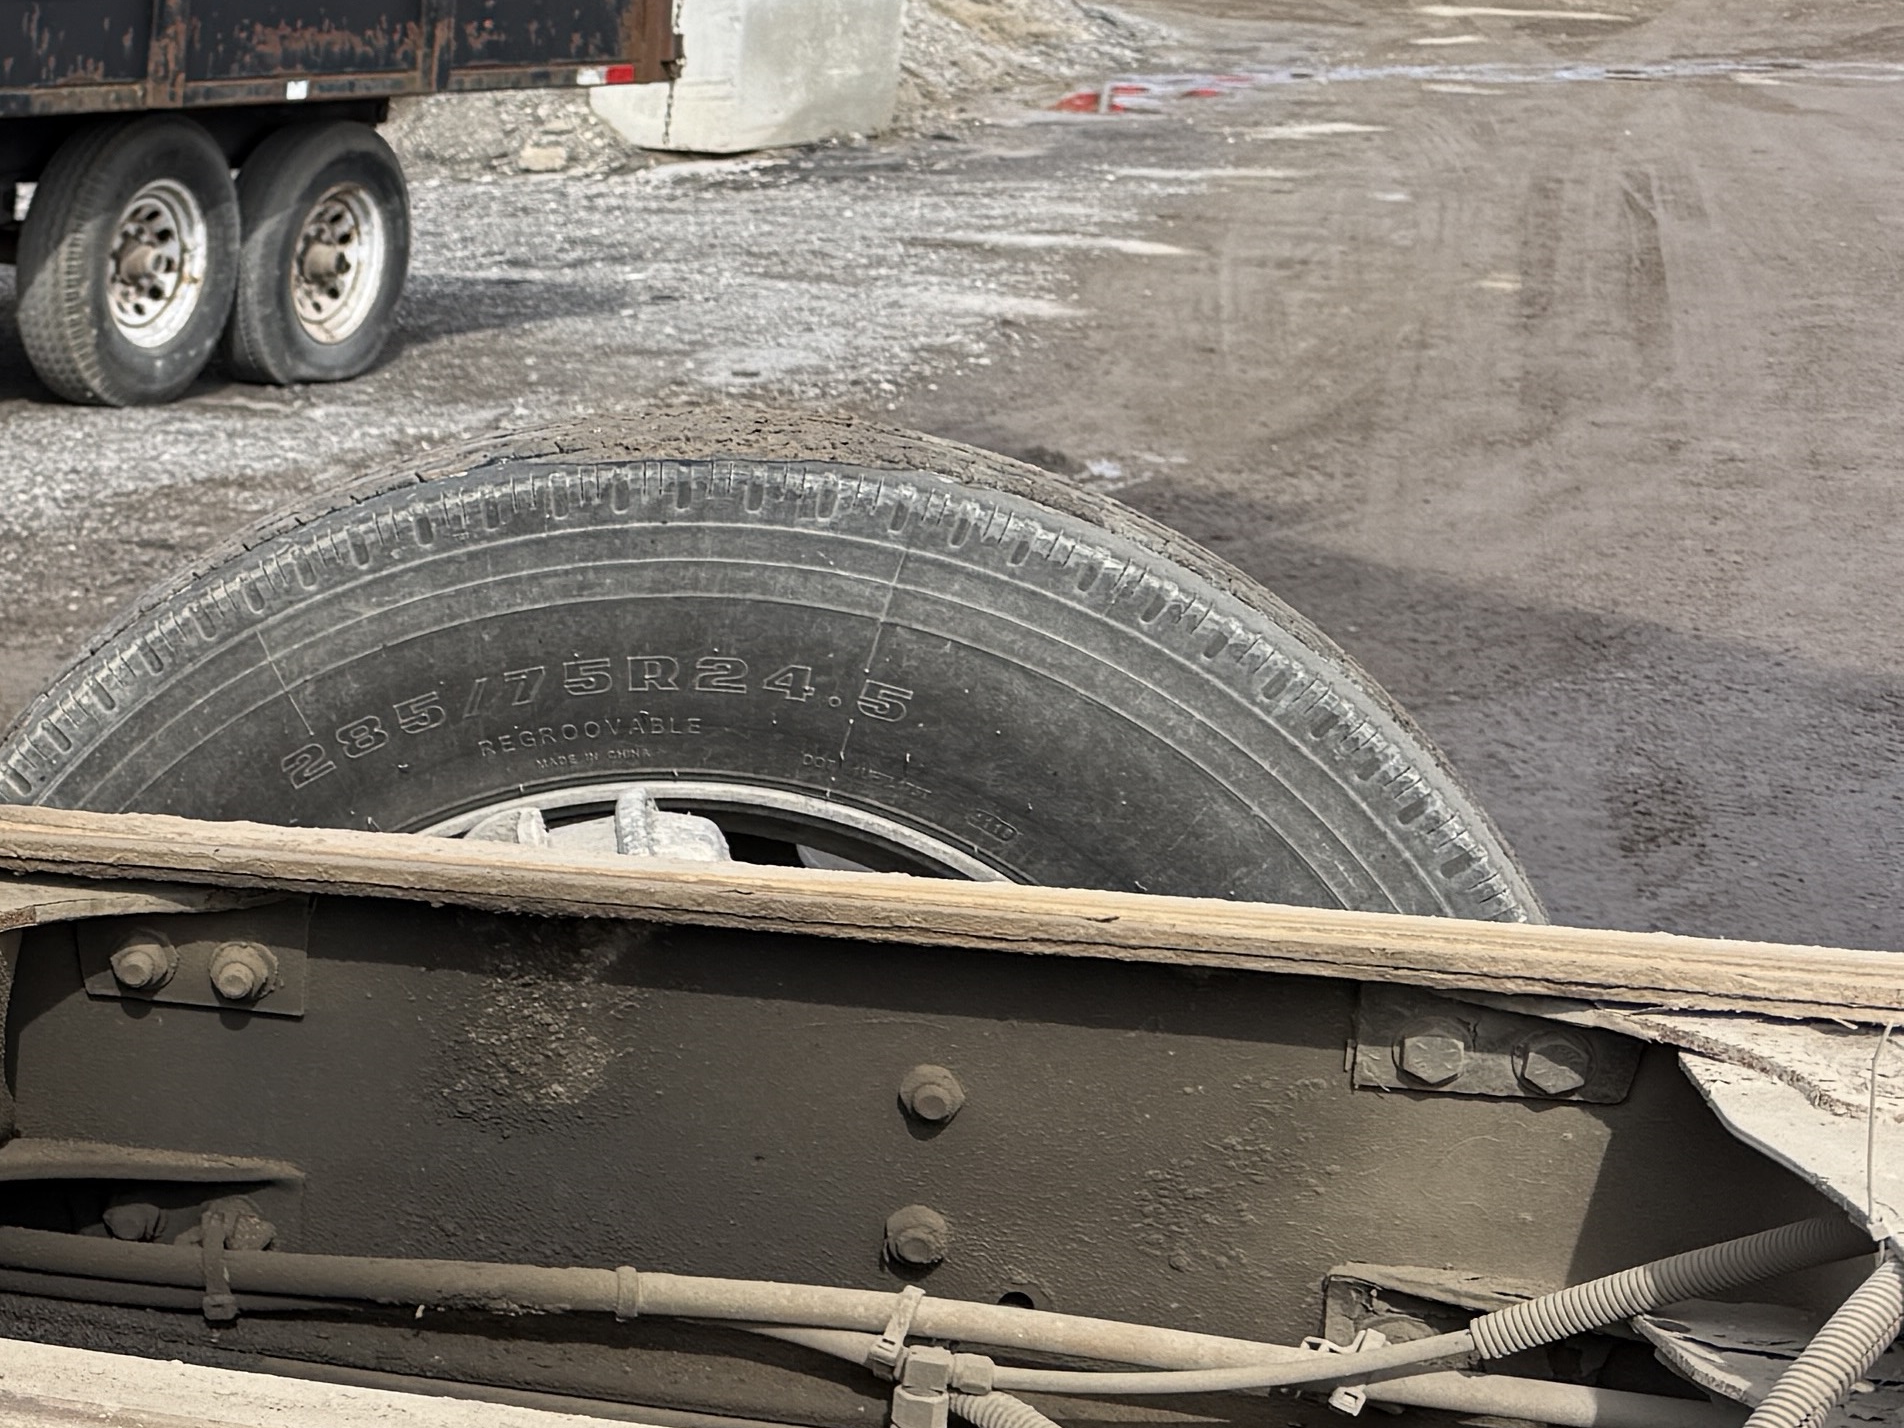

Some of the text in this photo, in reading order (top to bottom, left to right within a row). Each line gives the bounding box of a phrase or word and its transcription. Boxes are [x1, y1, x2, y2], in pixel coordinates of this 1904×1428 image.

[281, 655, 914, 789] 285/75R24.5
[478, 716, 702, 757] REGROOVABLE
[536, 748, 652, 769] MADE IN CHINA
[802, 753, 837, 769] DOT
